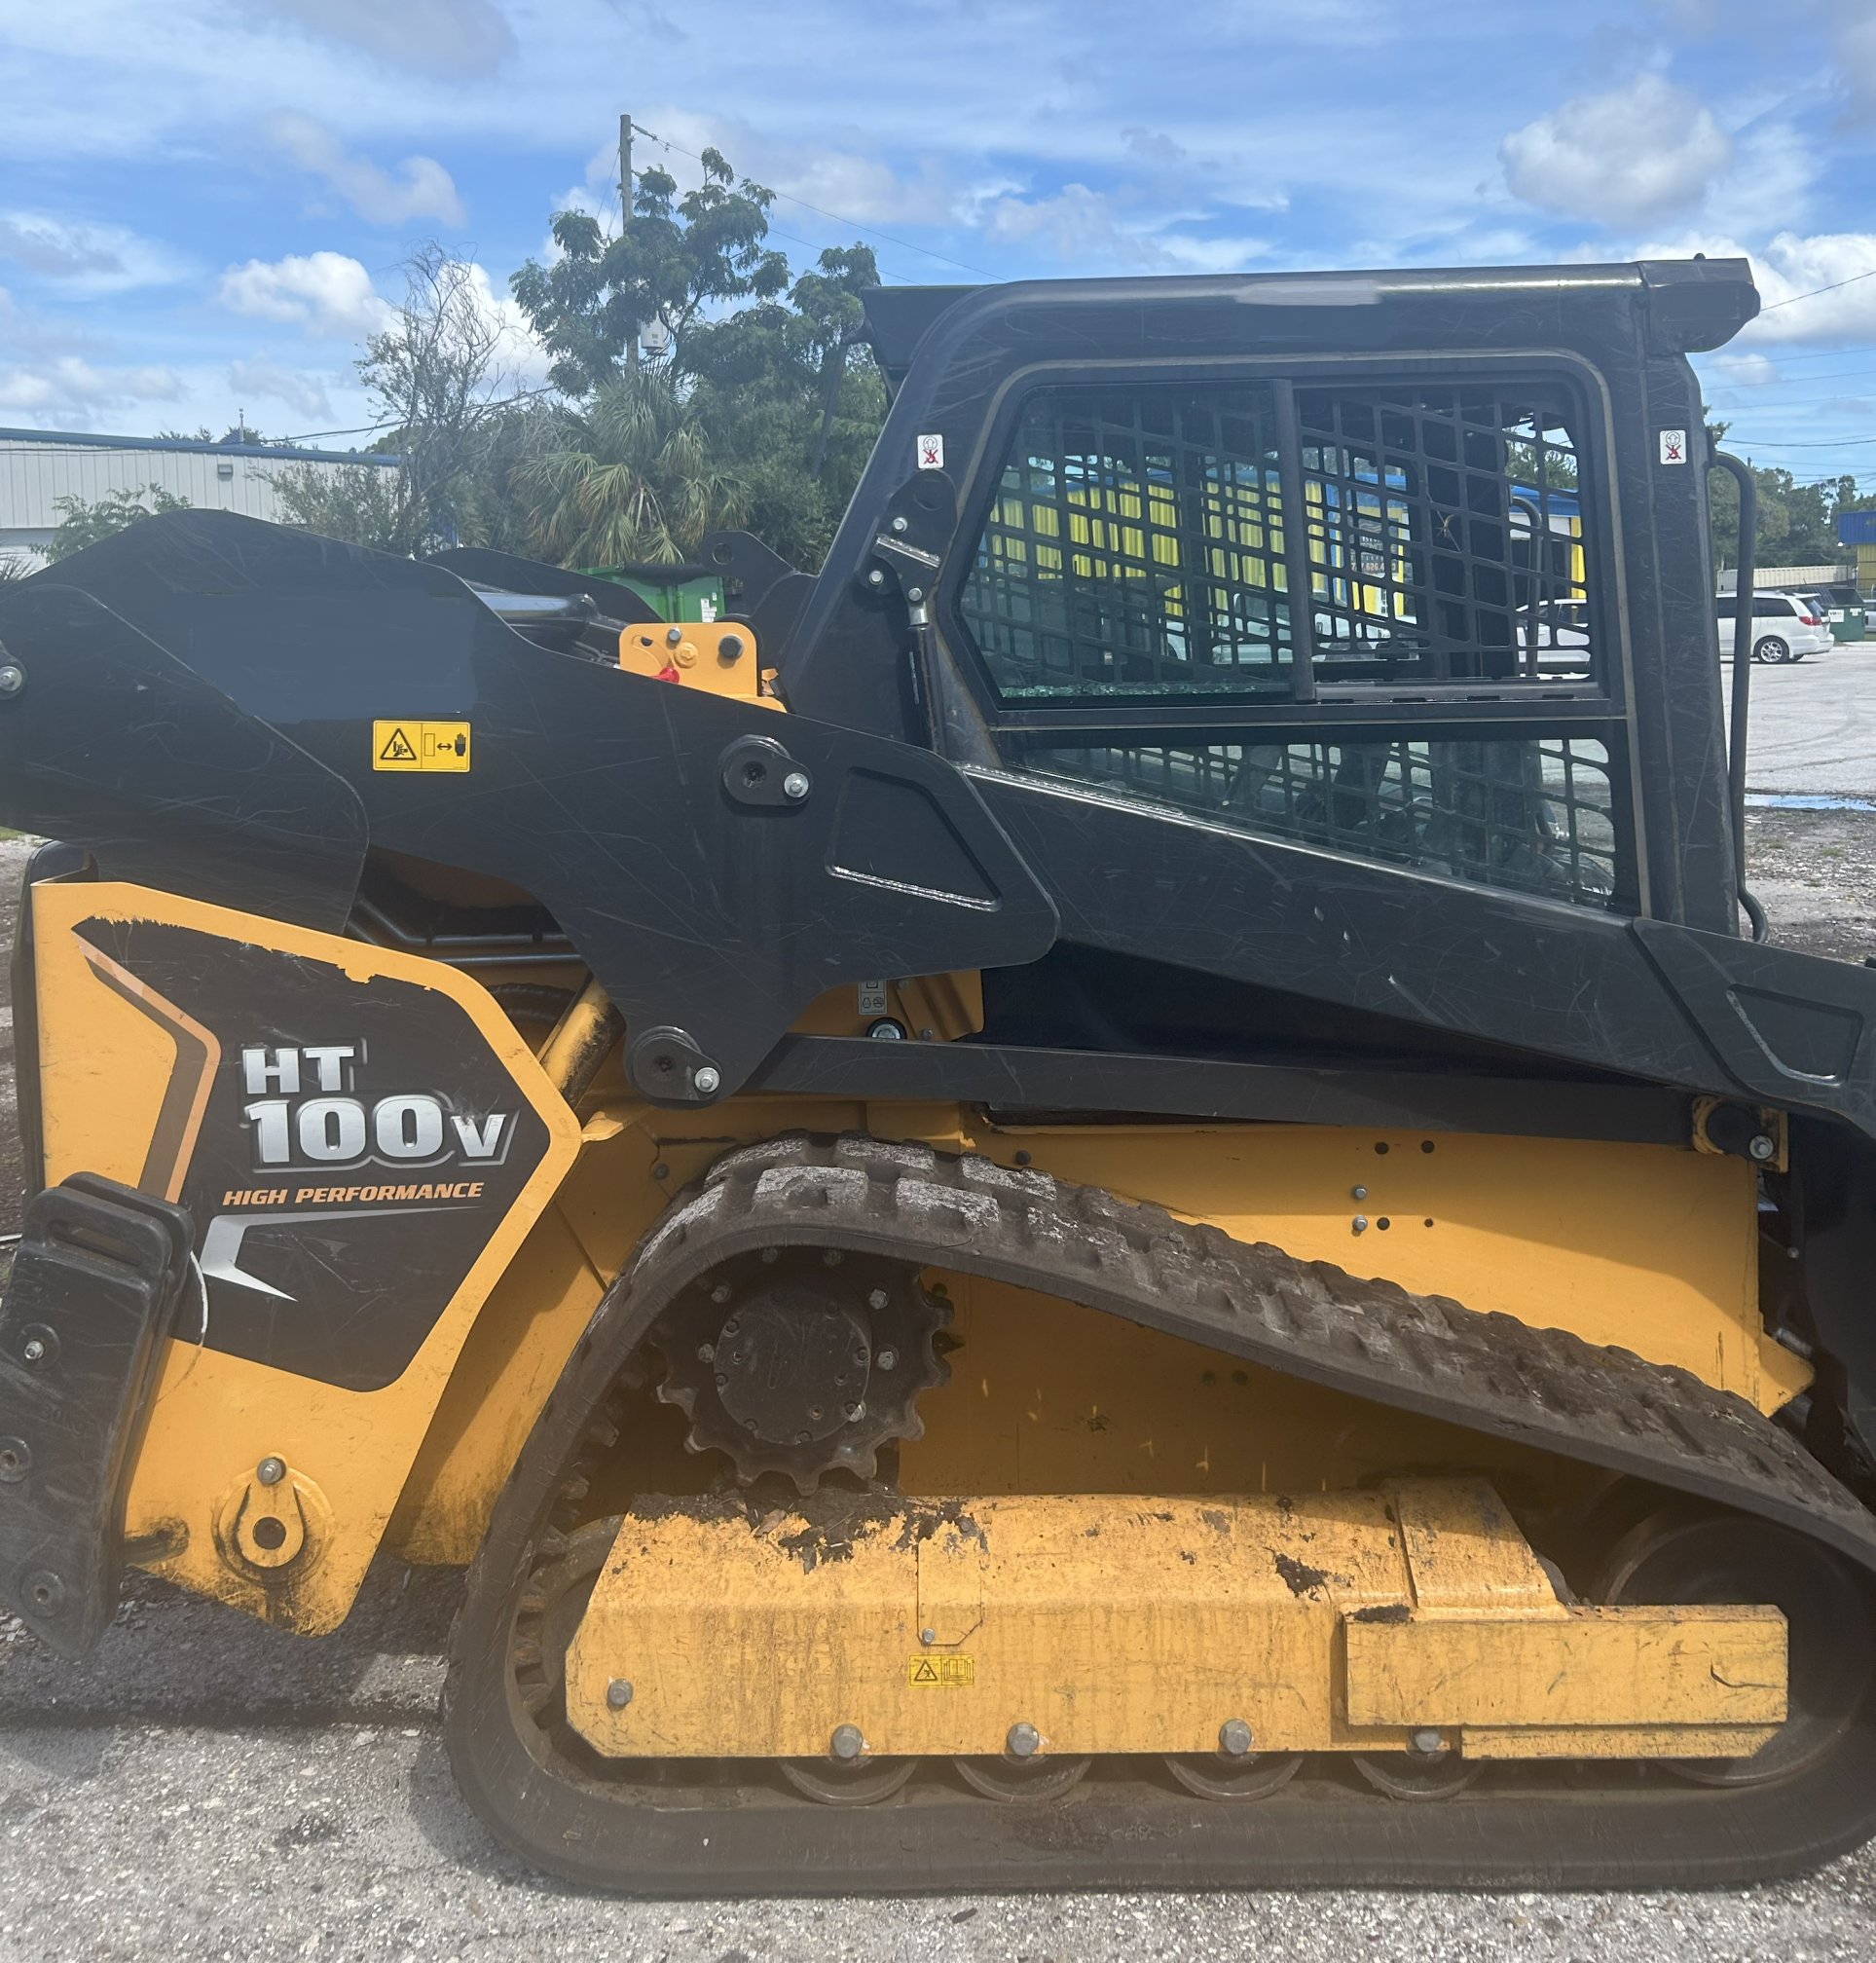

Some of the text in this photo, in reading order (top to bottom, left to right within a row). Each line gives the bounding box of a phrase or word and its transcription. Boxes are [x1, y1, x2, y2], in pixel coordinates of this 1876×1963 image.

[242, 1046, 354, 1094] HT
[222, 1182, 485, 1206] HIGH PERFORMANCE
